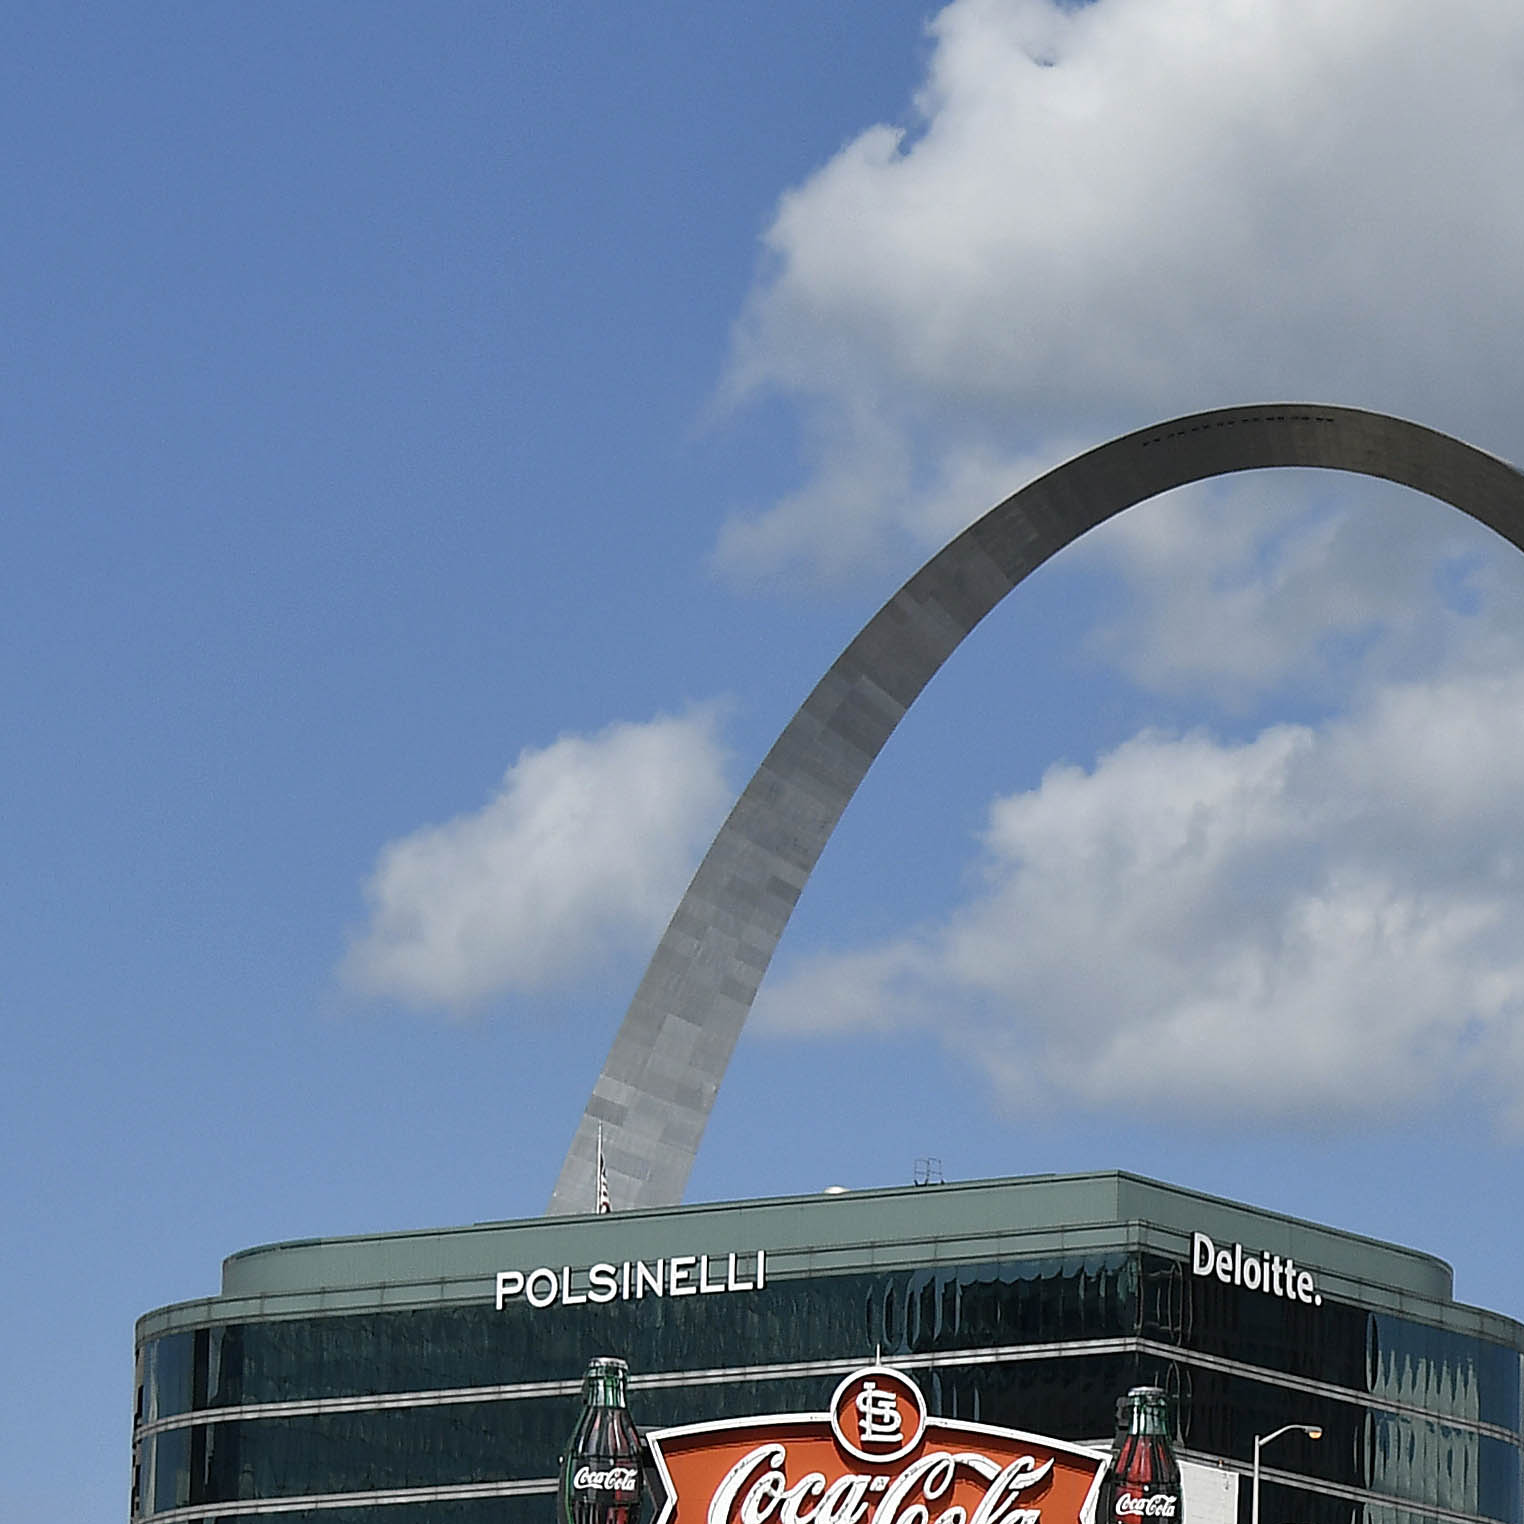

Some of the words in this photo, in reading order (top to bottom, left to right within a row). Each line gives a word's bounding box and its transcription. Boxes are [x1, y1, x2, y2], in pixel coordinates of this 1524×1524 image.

[496, 1250, 767, 1311] POLSINELLI
[573, 1466, 637, 1491] Coca-Cola
[1115, 1492, 1177, 1517] Coca-Cola
